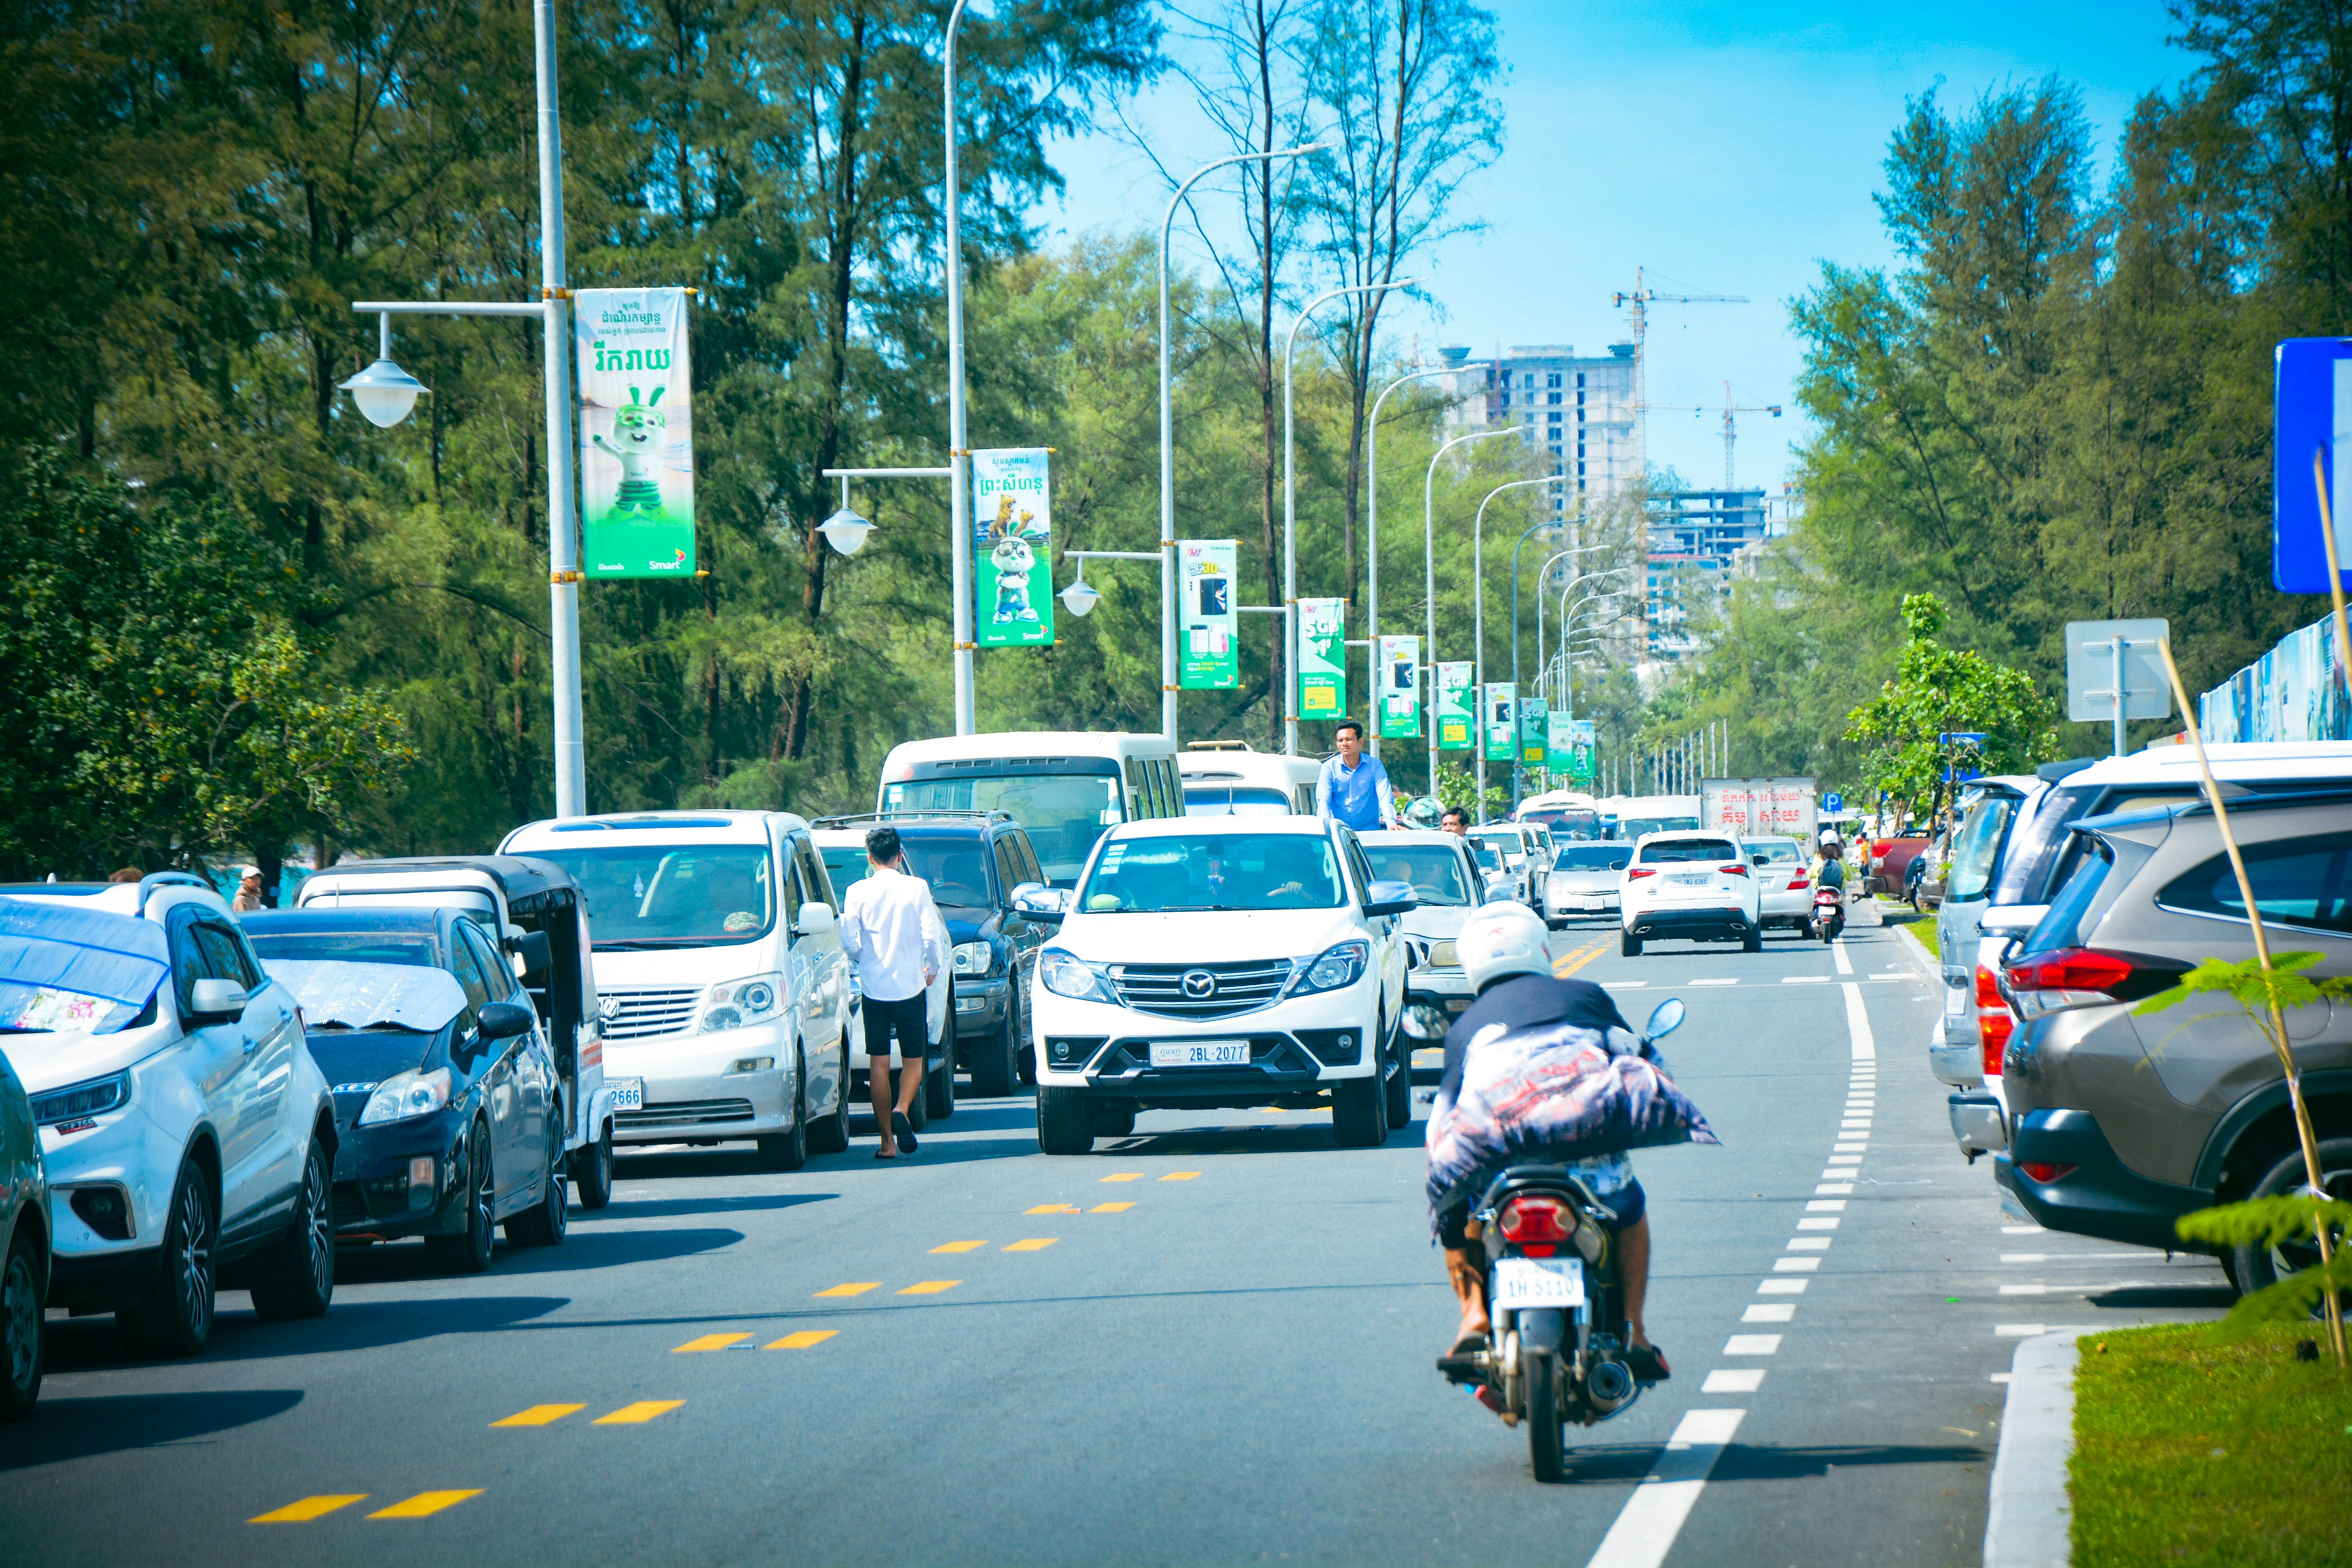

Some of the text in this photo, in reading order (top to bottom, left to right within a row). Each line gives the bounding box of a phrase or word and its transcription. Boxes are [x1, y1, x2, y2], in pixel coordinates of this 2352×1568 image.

[593, 340, 670, 371] រីករាយ
[649, 560, 680, 570] Smart
[1828, 795, 1838, 810] P
[1190, 1046, 1243, 1061] 2BL-2077
